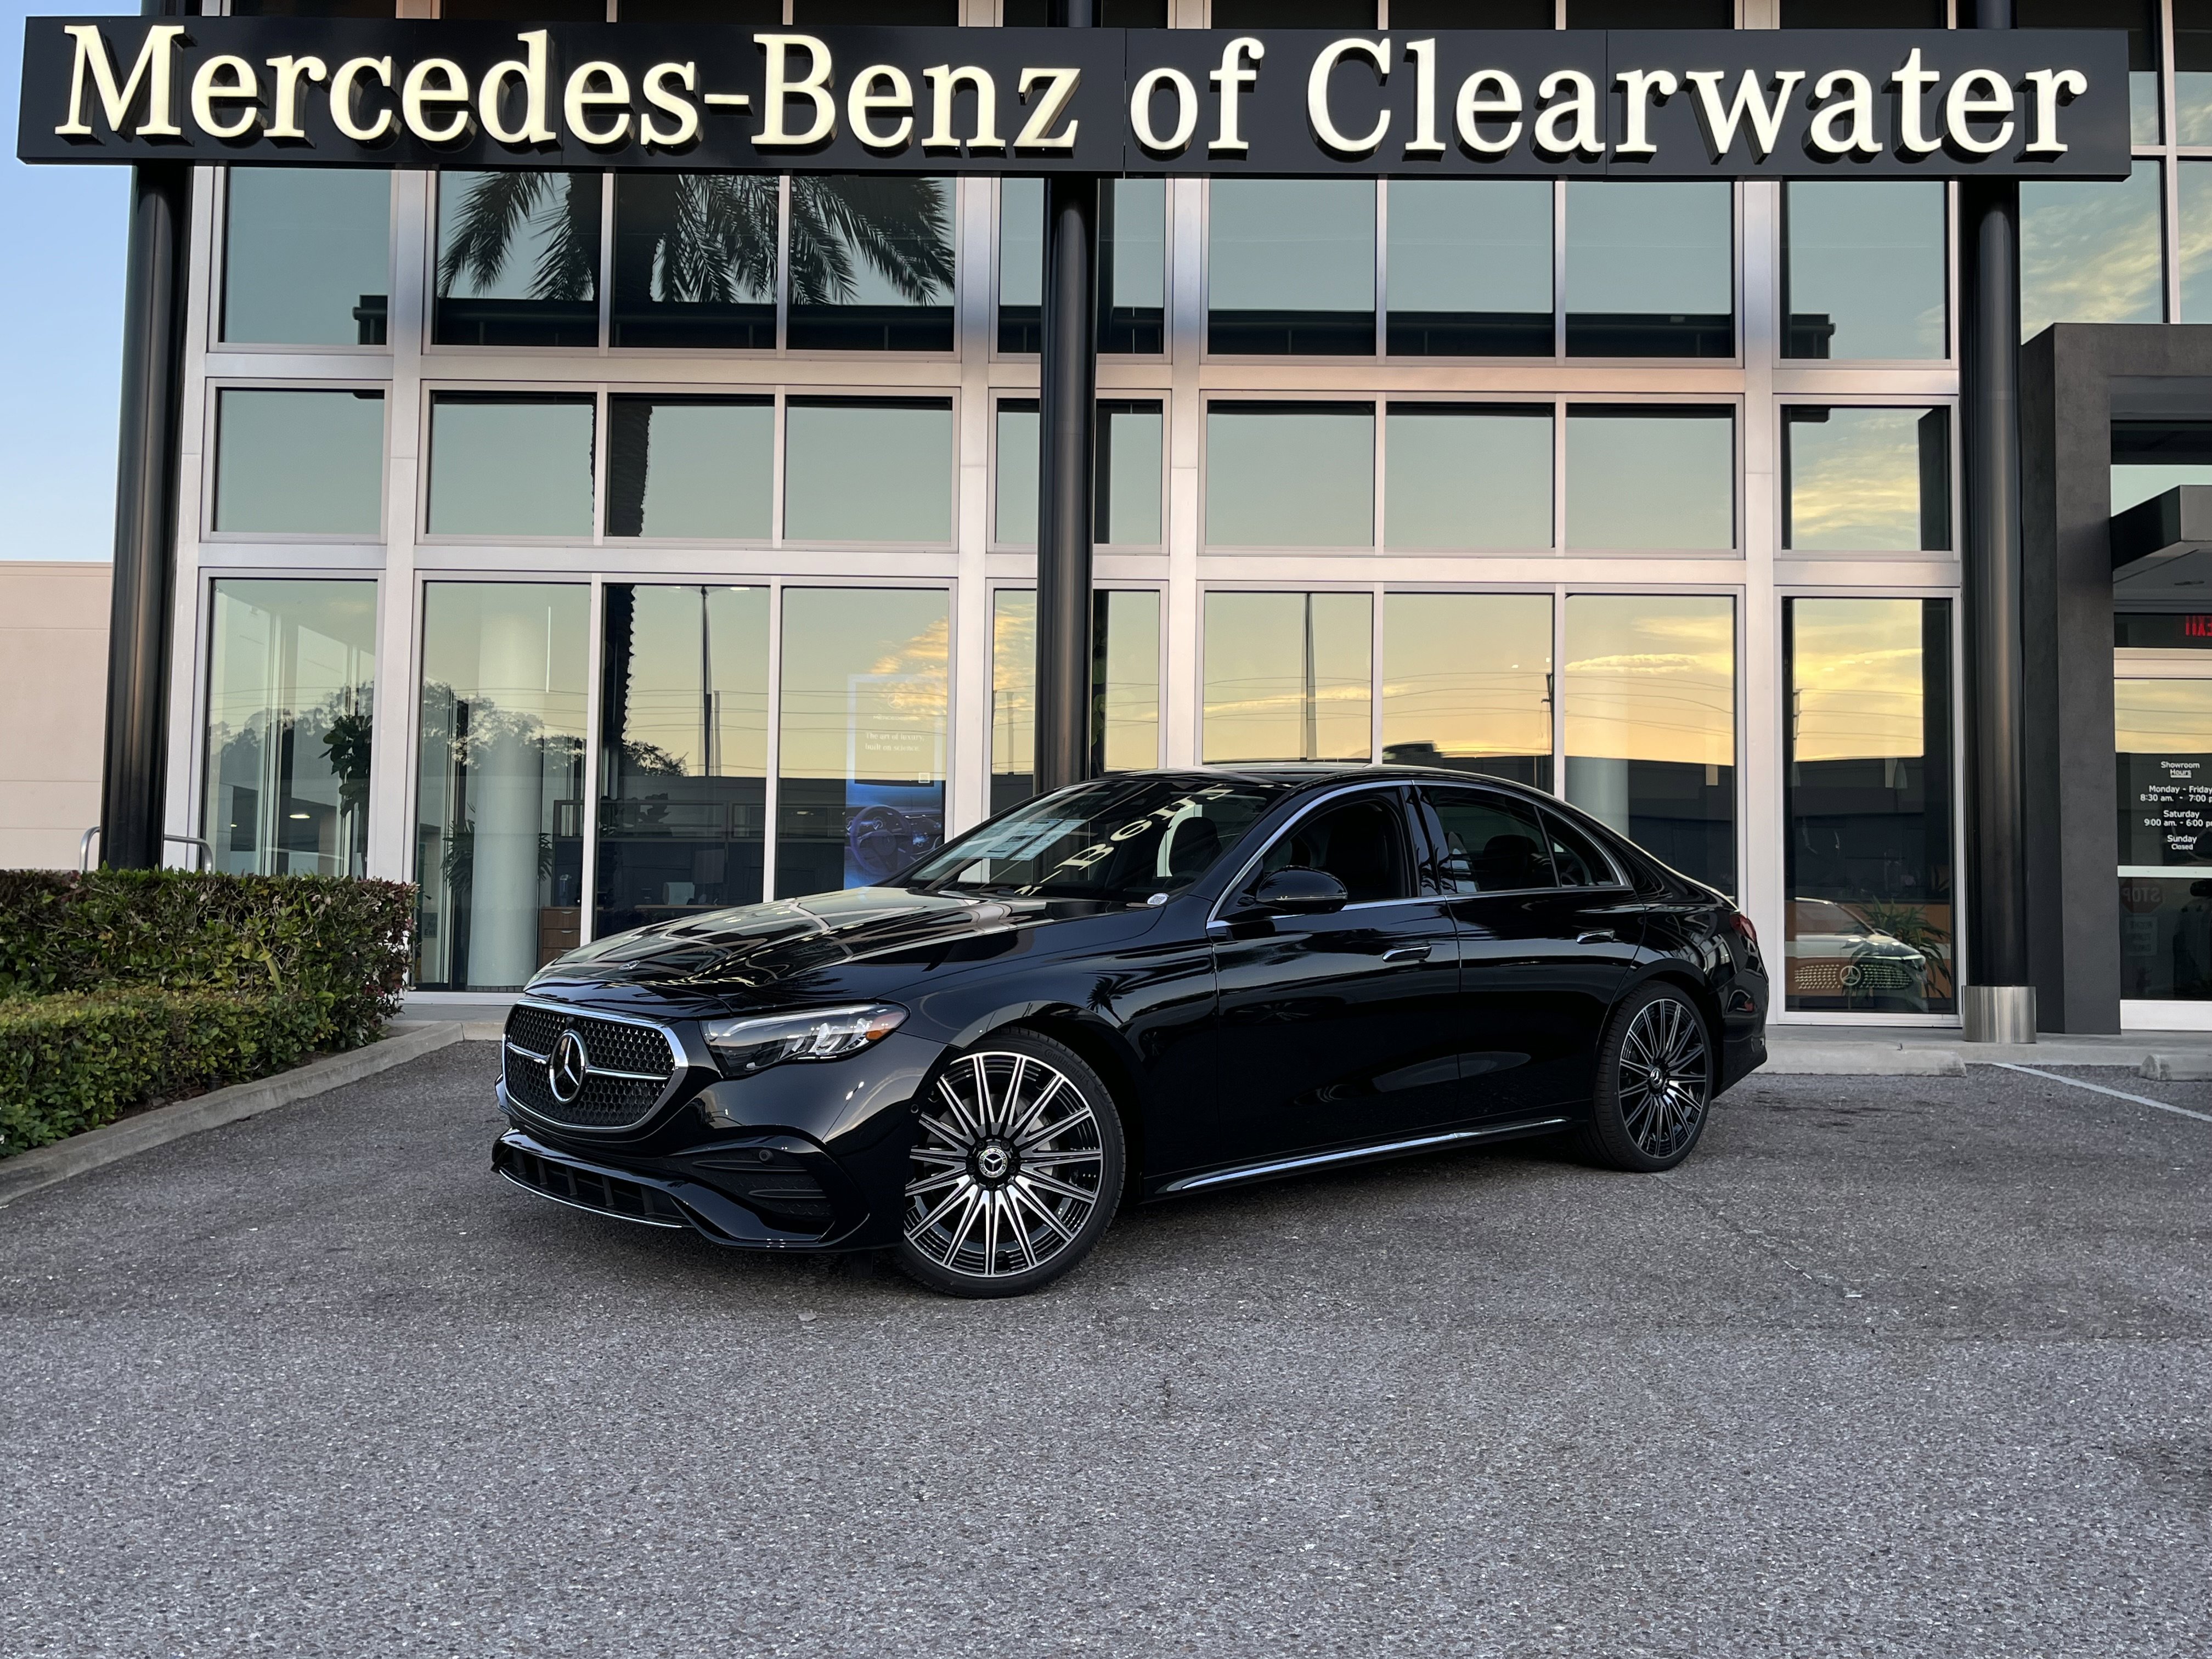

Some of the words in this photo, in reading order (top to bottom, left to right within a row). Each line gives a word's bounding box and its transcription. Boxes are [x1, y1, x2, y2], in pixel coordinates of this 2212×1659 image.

[54, 24, 1081, 151] Mercedes-Benz
[1130, 37, 1265, 152] of
[1307, 36, 2087, 155] Clearwater
[2149, 785, 2180, 794] Monday
[2189, 786, 2212, 794] Friday
[2163, 810, 2200, 819] Saturday
[2143, 818, 2162, 826] 9:00
[2167, 834, 2197, 844] Sunday
[1044, 1048, 1086, 1081] Continental
